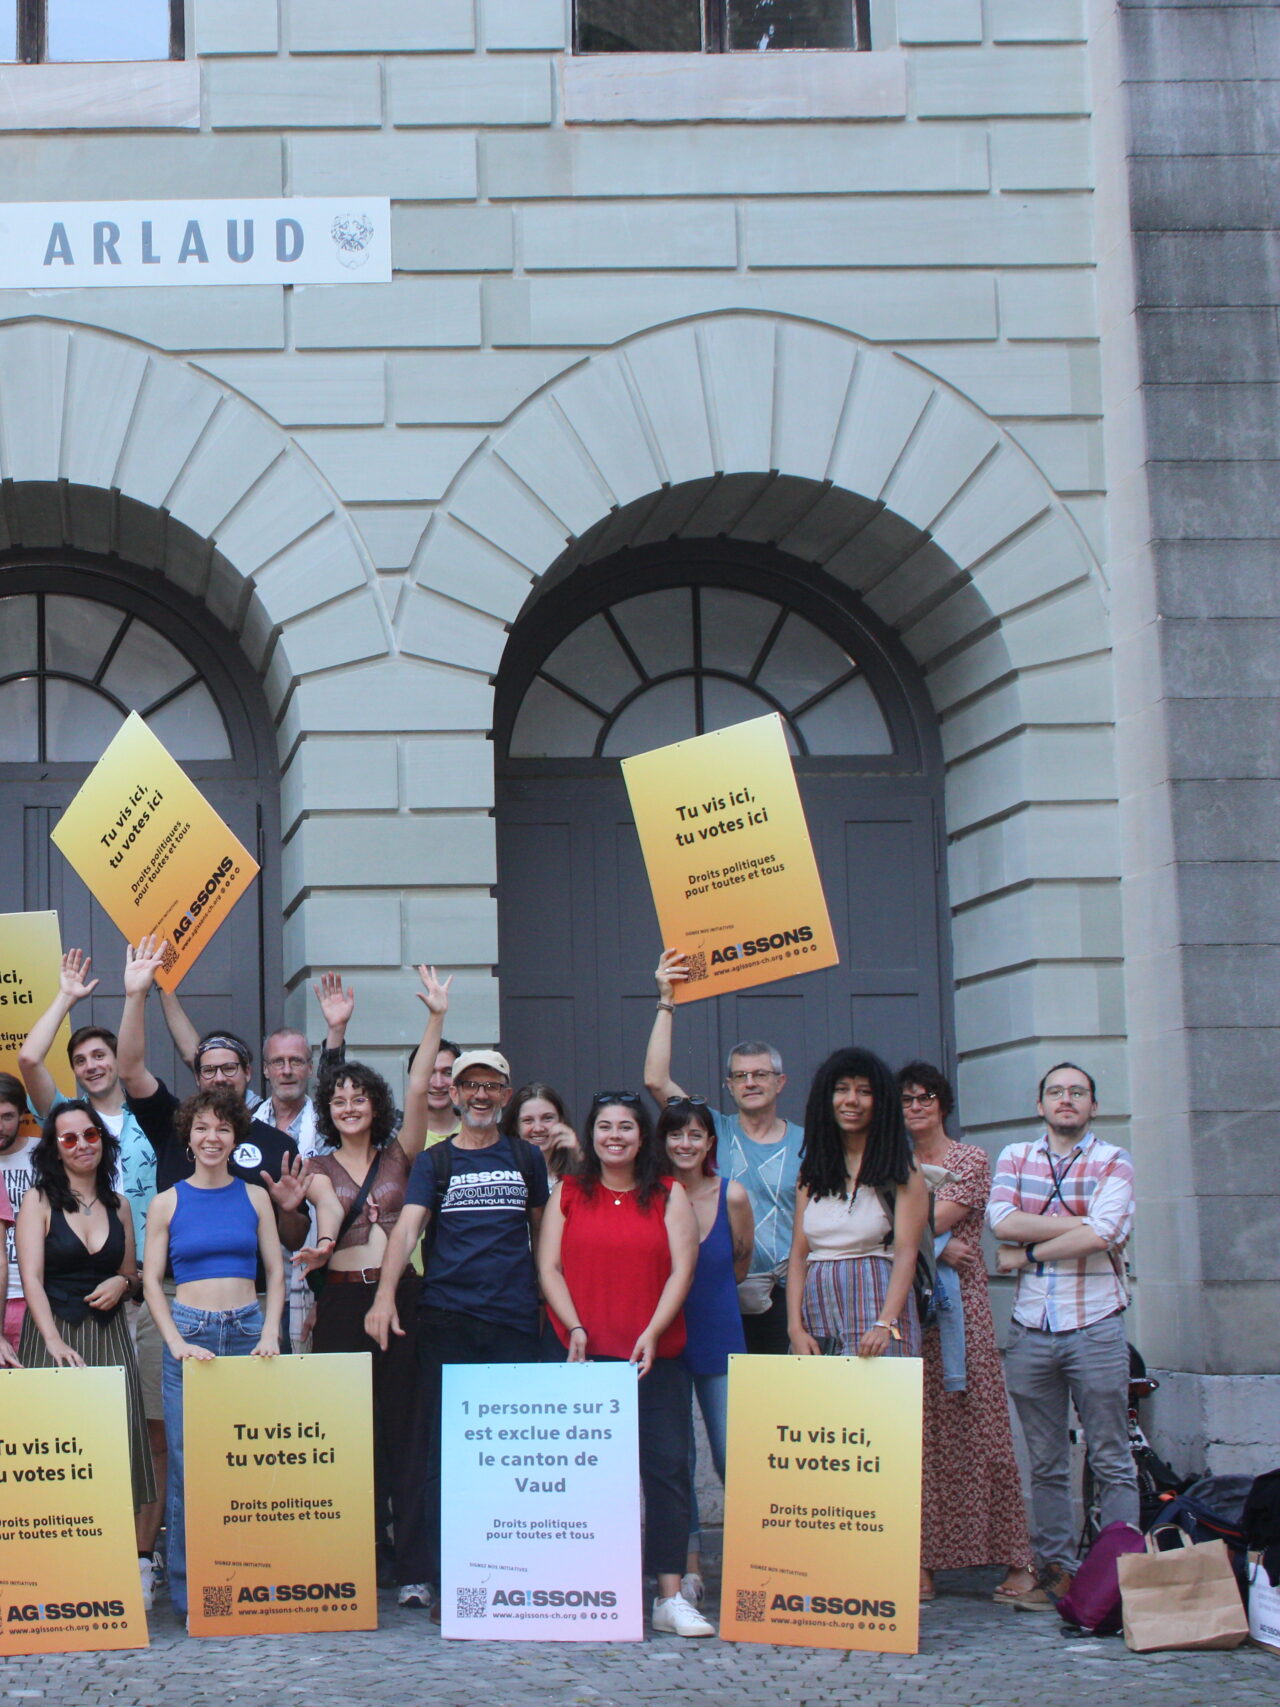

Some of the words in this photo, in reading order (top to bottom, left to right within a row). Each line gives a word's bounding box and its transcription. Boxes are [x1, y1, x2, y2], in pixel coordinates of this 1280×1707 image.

[44, 217, 306, 266] ARLAUD
[675, 805, 699, 822] Tu
[701, 796, 727, 814] vis
[728, 786, 756, 807] ici,
[100, 828, 118, 848] Tu
[115, 805, 132, 828] vis
[128, 784, 149, 807] ici,
[108, 850, 124, 869] tu
[121, 810, 151, 851] votes
[146, 789, 164, 812] ici
[674, 831, 695, 847] tu
[697, 817, 745, 840] votes
[746, 806, 769, 827] ici
[687, 869, 721, 885] Droits
[721, 853, 776, 878] politiques
[12, 990, 33, 1004] ici
[5, 1042, 17, 1051] et
[461, 1400, 469, 1415] 1
[478, 1402, 568, 1419] personne
[572, 1402, 604, 1415] sur
[609, 1398, 621, 1415] 3
[233, 1423, 259, 1441] Tu
[263, 1422, 292, 1440] vis
[297, 1421, 326, 1440] ici,
[463, 1426, 493, 1441] est
[497, 1424, 561, 1441] exclue
[565, 1424, 613, 1440] dans
[776, 1424, 802, 1443] Tu
[807, 1426, 836, 1444] vis
[841, 1426, 871, 1448] ici,
[21, 1437, 50, 1455] vis
[54, 1436, 83, 1456] ici,
[225, 1451, 248, 1467] tu
[252, 1449, 307, 1466] votes
[312, 1446, 335, 1464] ici
[478, 1451, 496, 1467] le
[500, 1451, 569, 1467] canton
[573, 1450, 599, 1467] de
[767, 1452, 790, 1470] tu
[794, 1454, 851, 1472] votes
[856, 1455, 880, 1473] ici
[12, 1465, 66, 1483] votes
[70, 1462, 93, 1480] ici
[514, 1477, 566, 1493] Vaud
[230, 1498, 268, 1511] Droits
[270, 1497, 333, 1512] politiques
[769, 1502, 808, 1516] Droits
[810, 1505, 877, 1521] politiques
[32, 1514, 95, 1529] politiques
[222, 1514, 253, 1526] pour
[254, 1511, 296, 1523] toutes
[297, 1509, 311, 1521] et
[313, 1509, 341, 1520] tous
[493, 1518, 528, 1529] Droits
[529, 1518, 588, 1531] politiques
[761, 1517, 792, 1529] pour
[794, 1517, 836, 1531] toutes
[838, 1520, 853, 1531] et
[855, 1520, 884, 1533] tous
[17, 1528, 58, 1540] toutes
[60, 1527, 74, 1538] et
[75, 1526, 103, 1537] tous
[485, 1531, 514, 1542] pour
[515, 1529, 553, 1540] toutes
[554, 1530, 568, 1540] et
[569, 1530, 595, 1540] tous
